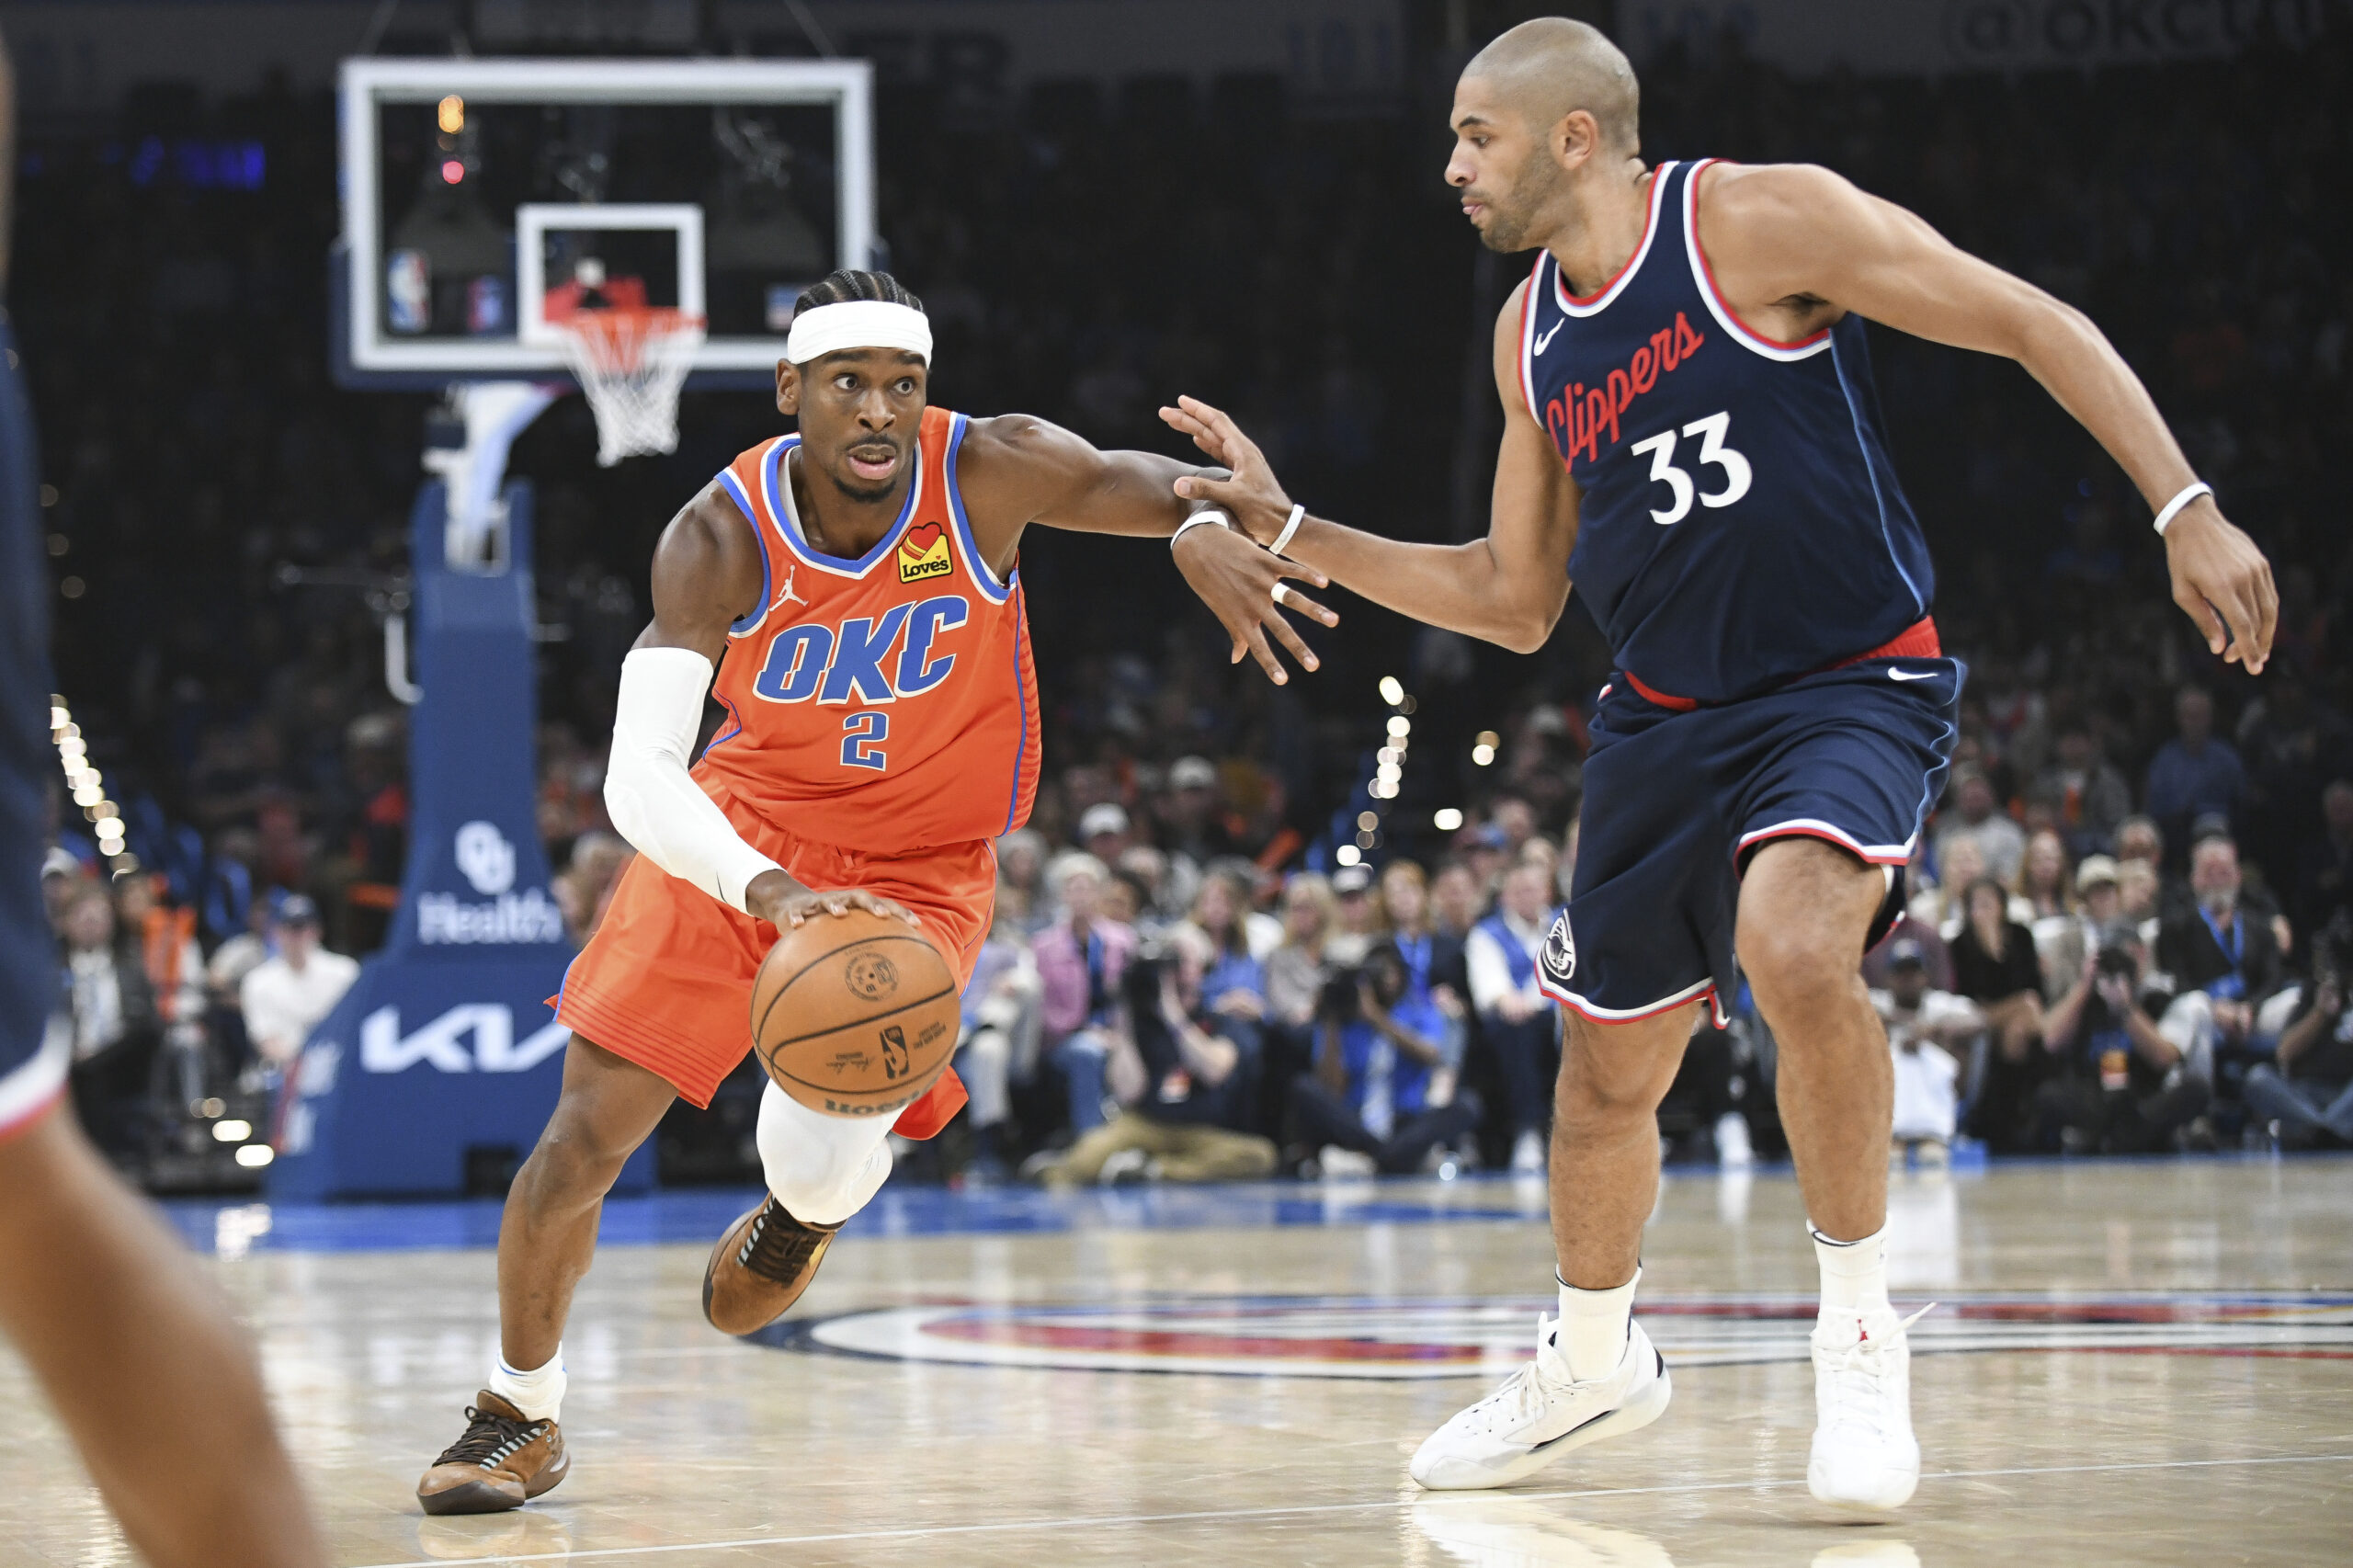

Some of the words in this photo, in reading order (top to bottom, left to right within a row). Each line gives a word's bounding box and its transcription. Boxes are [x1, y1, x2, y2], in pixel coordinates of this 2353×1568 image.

[1546, 312, 1705, 475] Clippers
[1631, 410, 1753, 525] 33
[752, 596, 971, 706] OKC
[840, 712, 891, 771] 2
[416, 890, 564, 946] Health
